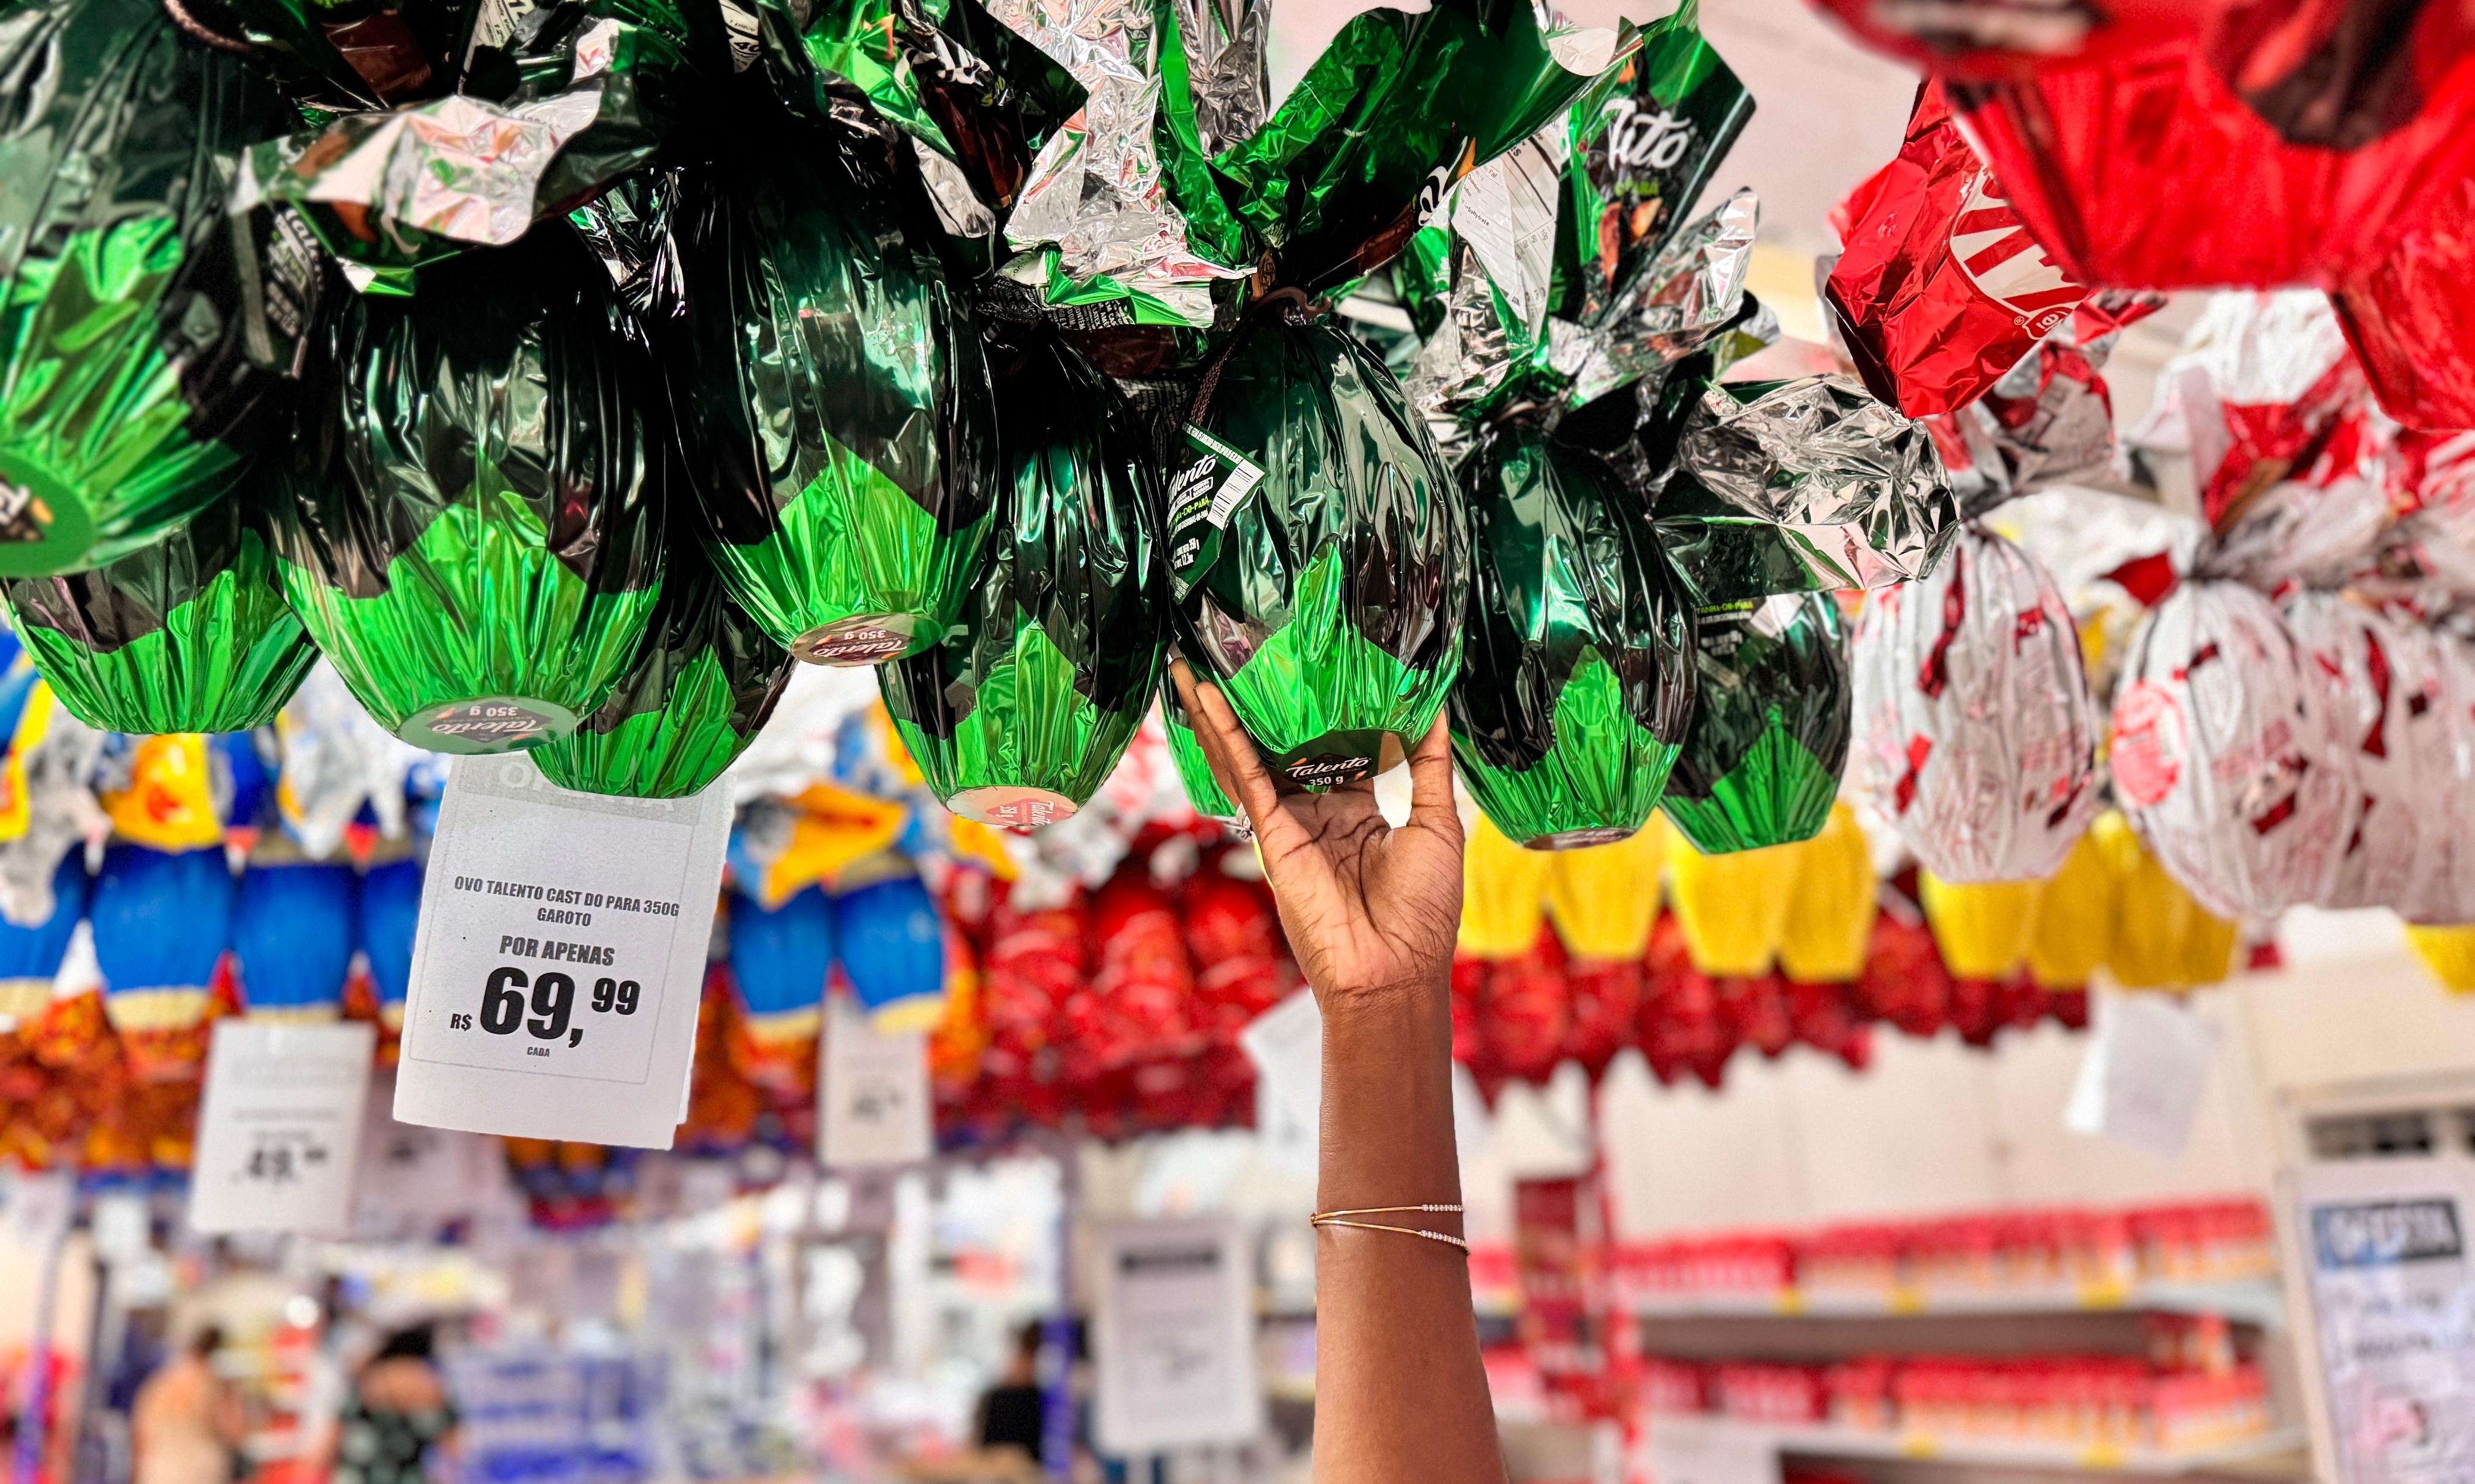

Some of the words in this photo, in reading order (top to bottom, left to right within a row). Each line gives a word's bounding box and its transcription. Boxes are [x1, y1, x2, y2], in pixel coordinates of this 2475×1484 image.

[844, 632, 854, 640] g
[859, 630, 886, 640] 350
[813, 640, 907, 657] Talento
[469, 706, 481, 716] g
[486, 707, 518, 717] 350
[432, 720, 543, 735] Talento
[1286, 757, 1370, 777] Talento
[1309, 776, 1332, 786] 350
[1335, 776, 1344, 785] g
[455, 876, 483, 892] OVO
[487, 880, 543, 900] TALENTO
[546, 888, 582, 905] CAST
[584, 893, 603, 908] DO
[605, 896, 641, 912] PARA
[643, 900, 680, 917] 350G
[537, 907, 592, 927] GAROTO
[499, 935, 539, 958] POR
[541, 940, 616, 967] APENAS
[450, 1013, 473, 1031] R$
[480, 967, 584, 1049] 69,
[591, 977, 641, 1016] 99
[527, 1046, 550, 1058] CADA
